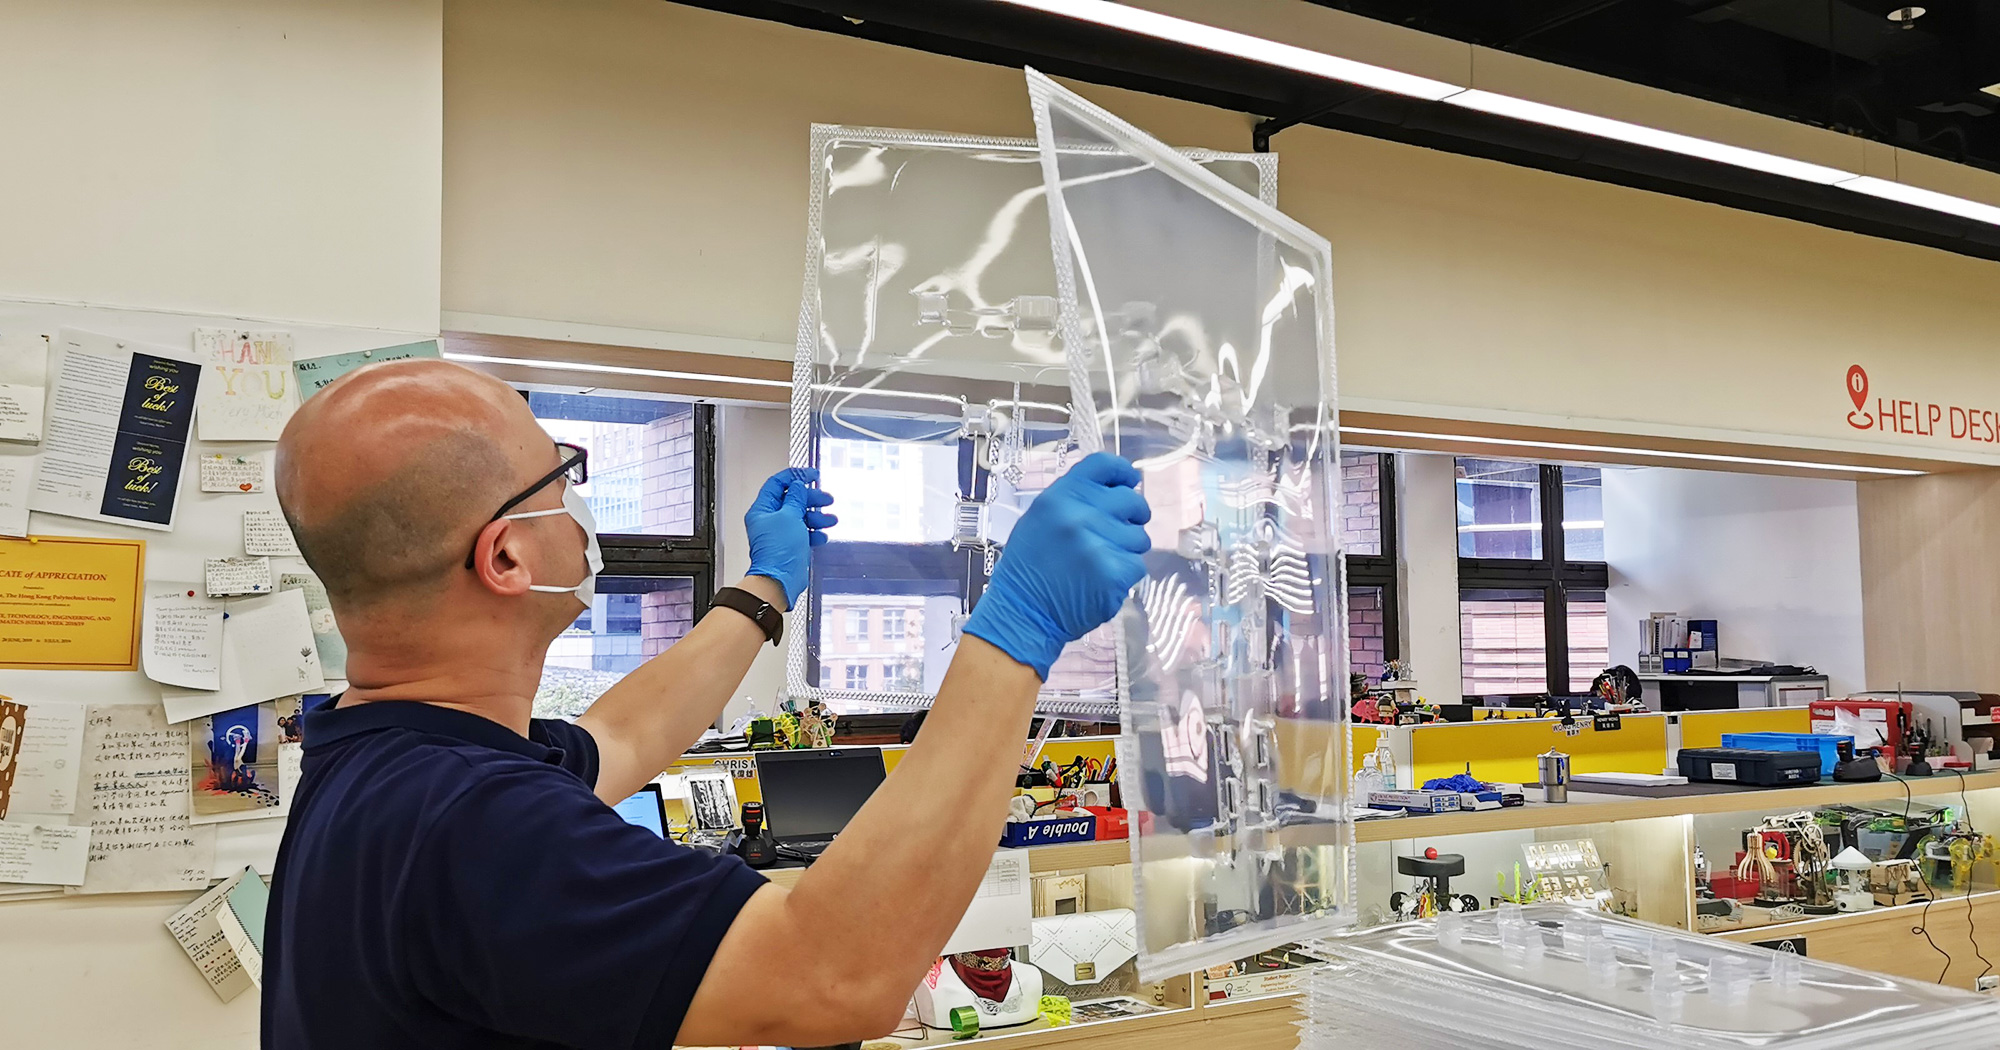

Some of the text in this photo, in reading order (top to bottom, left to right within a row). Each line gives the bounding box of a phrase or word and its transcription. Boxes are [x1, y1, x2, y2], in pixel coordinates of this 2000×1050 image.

[144, 375, 179, 394] Best
[216, 365, 286, 400] YOU
[152, 391, 168, 403] of
[141, 397, 175, 412] luck!
[1878, 398, 1941, 436] HELP
[127, 456, 163, 475] Best
[136, 472, 151, 484] of
[124, 481, 159, 493] luck!
[25, 571, 33, 579] of
[35, 571, 107, 581] APPRECIATION
[87, 595, 116, 603] University
[1572, 720, 1592, 730] HENRY
[714, 759, 749, 769] CHRIS
[1028, 821, 1090, 840] Double A
